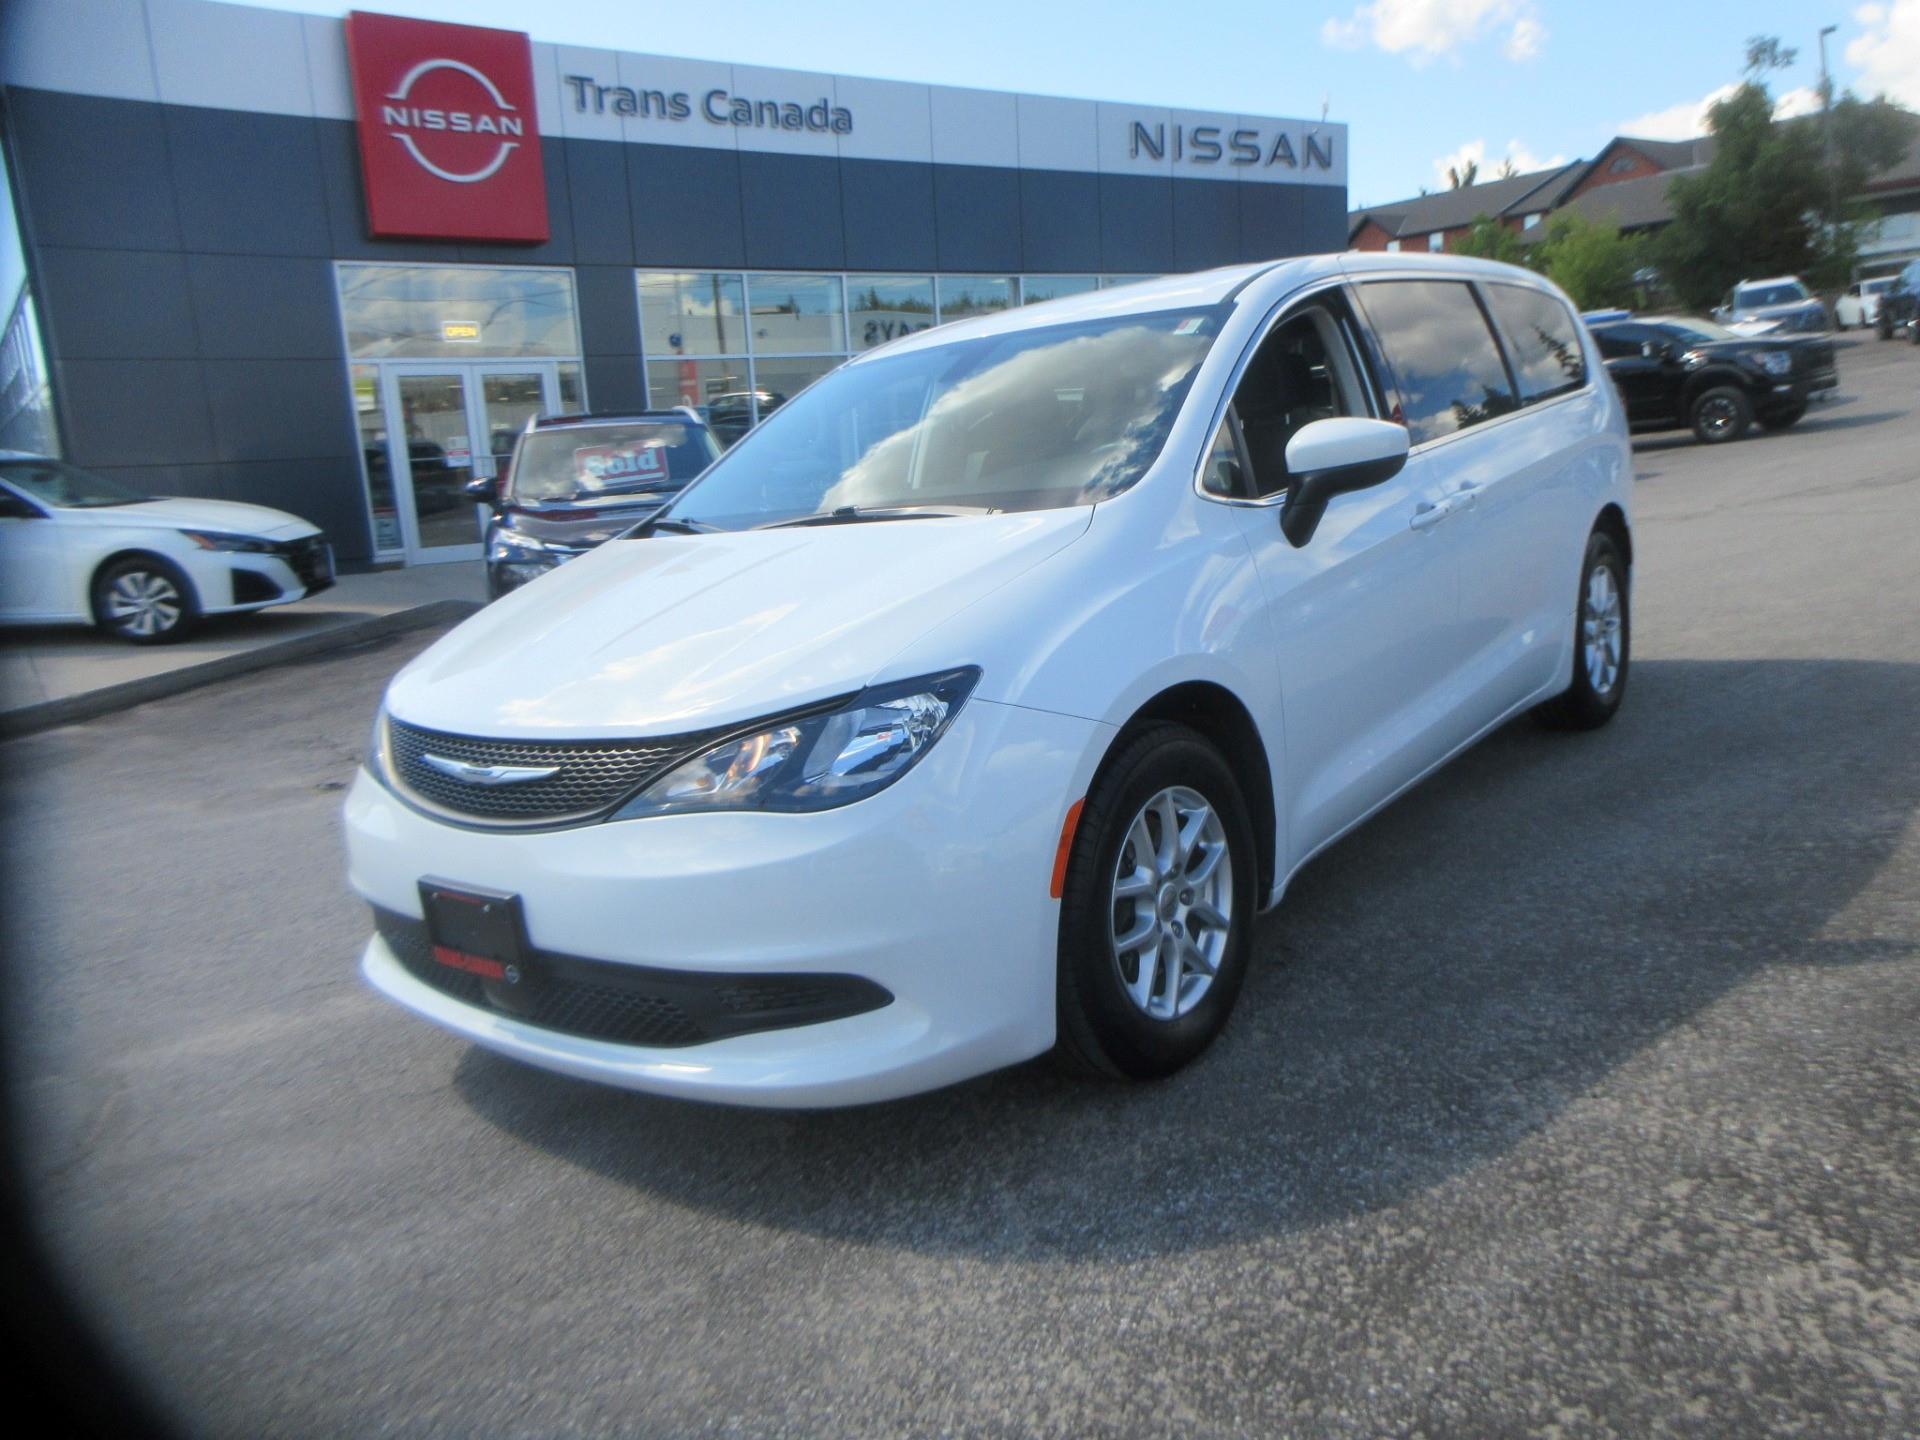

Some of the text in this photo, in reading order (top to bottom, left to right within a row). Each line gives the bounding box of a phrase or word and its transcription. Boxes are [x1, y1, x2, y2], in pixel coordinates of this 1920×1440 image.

[564, 74, 854, 135] Trans Canada
[382, 105, 524, 137] NISSAN
[1130, 120, 1333, 171] NISSAN
[446, 326, 477, 338] OPEN
[584, 447, 660, 477] Sold
